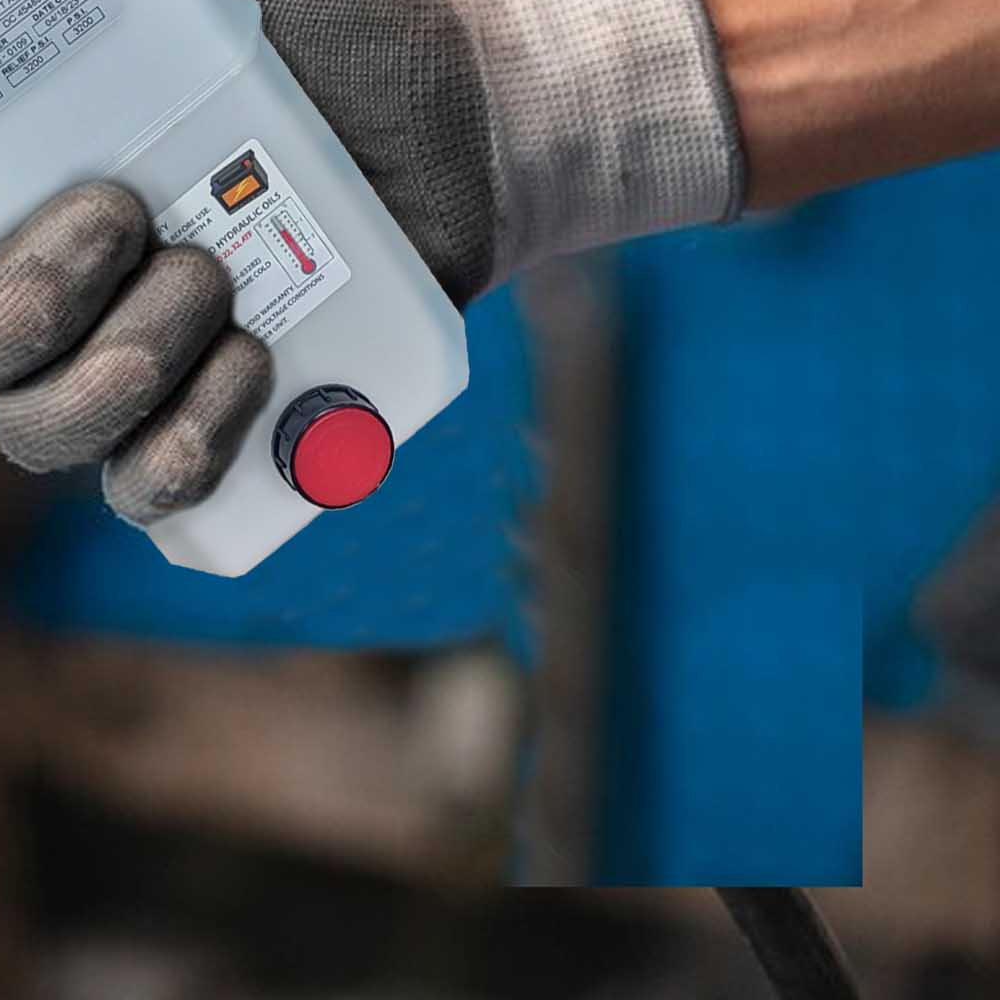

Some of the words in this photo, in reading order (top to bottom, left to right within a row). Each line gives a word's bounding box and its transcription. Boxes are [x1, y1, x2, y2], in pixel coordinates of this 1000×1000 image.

[2, 14, 17, 29] DC
[32, 1, 55, 21] DATE
[73, 16, 94, 36] 3200
[1, 49, 30, 76] RELIEF
[23, 55, 44, 74] 3200
[170, 219, 196, 243] BEFORE
[215, 207, 262, 249] HYDRAULIC
[261, 192, 282, 211] OILS
[187, 221, 207, 242] WITH
[253, 261, 273, 280] COLD
[260, 285, 295, 317] WARRANTY
[262, 304, 289, 328] VOLTAGE
[287, 273, 326, 307] CONDITIONS
